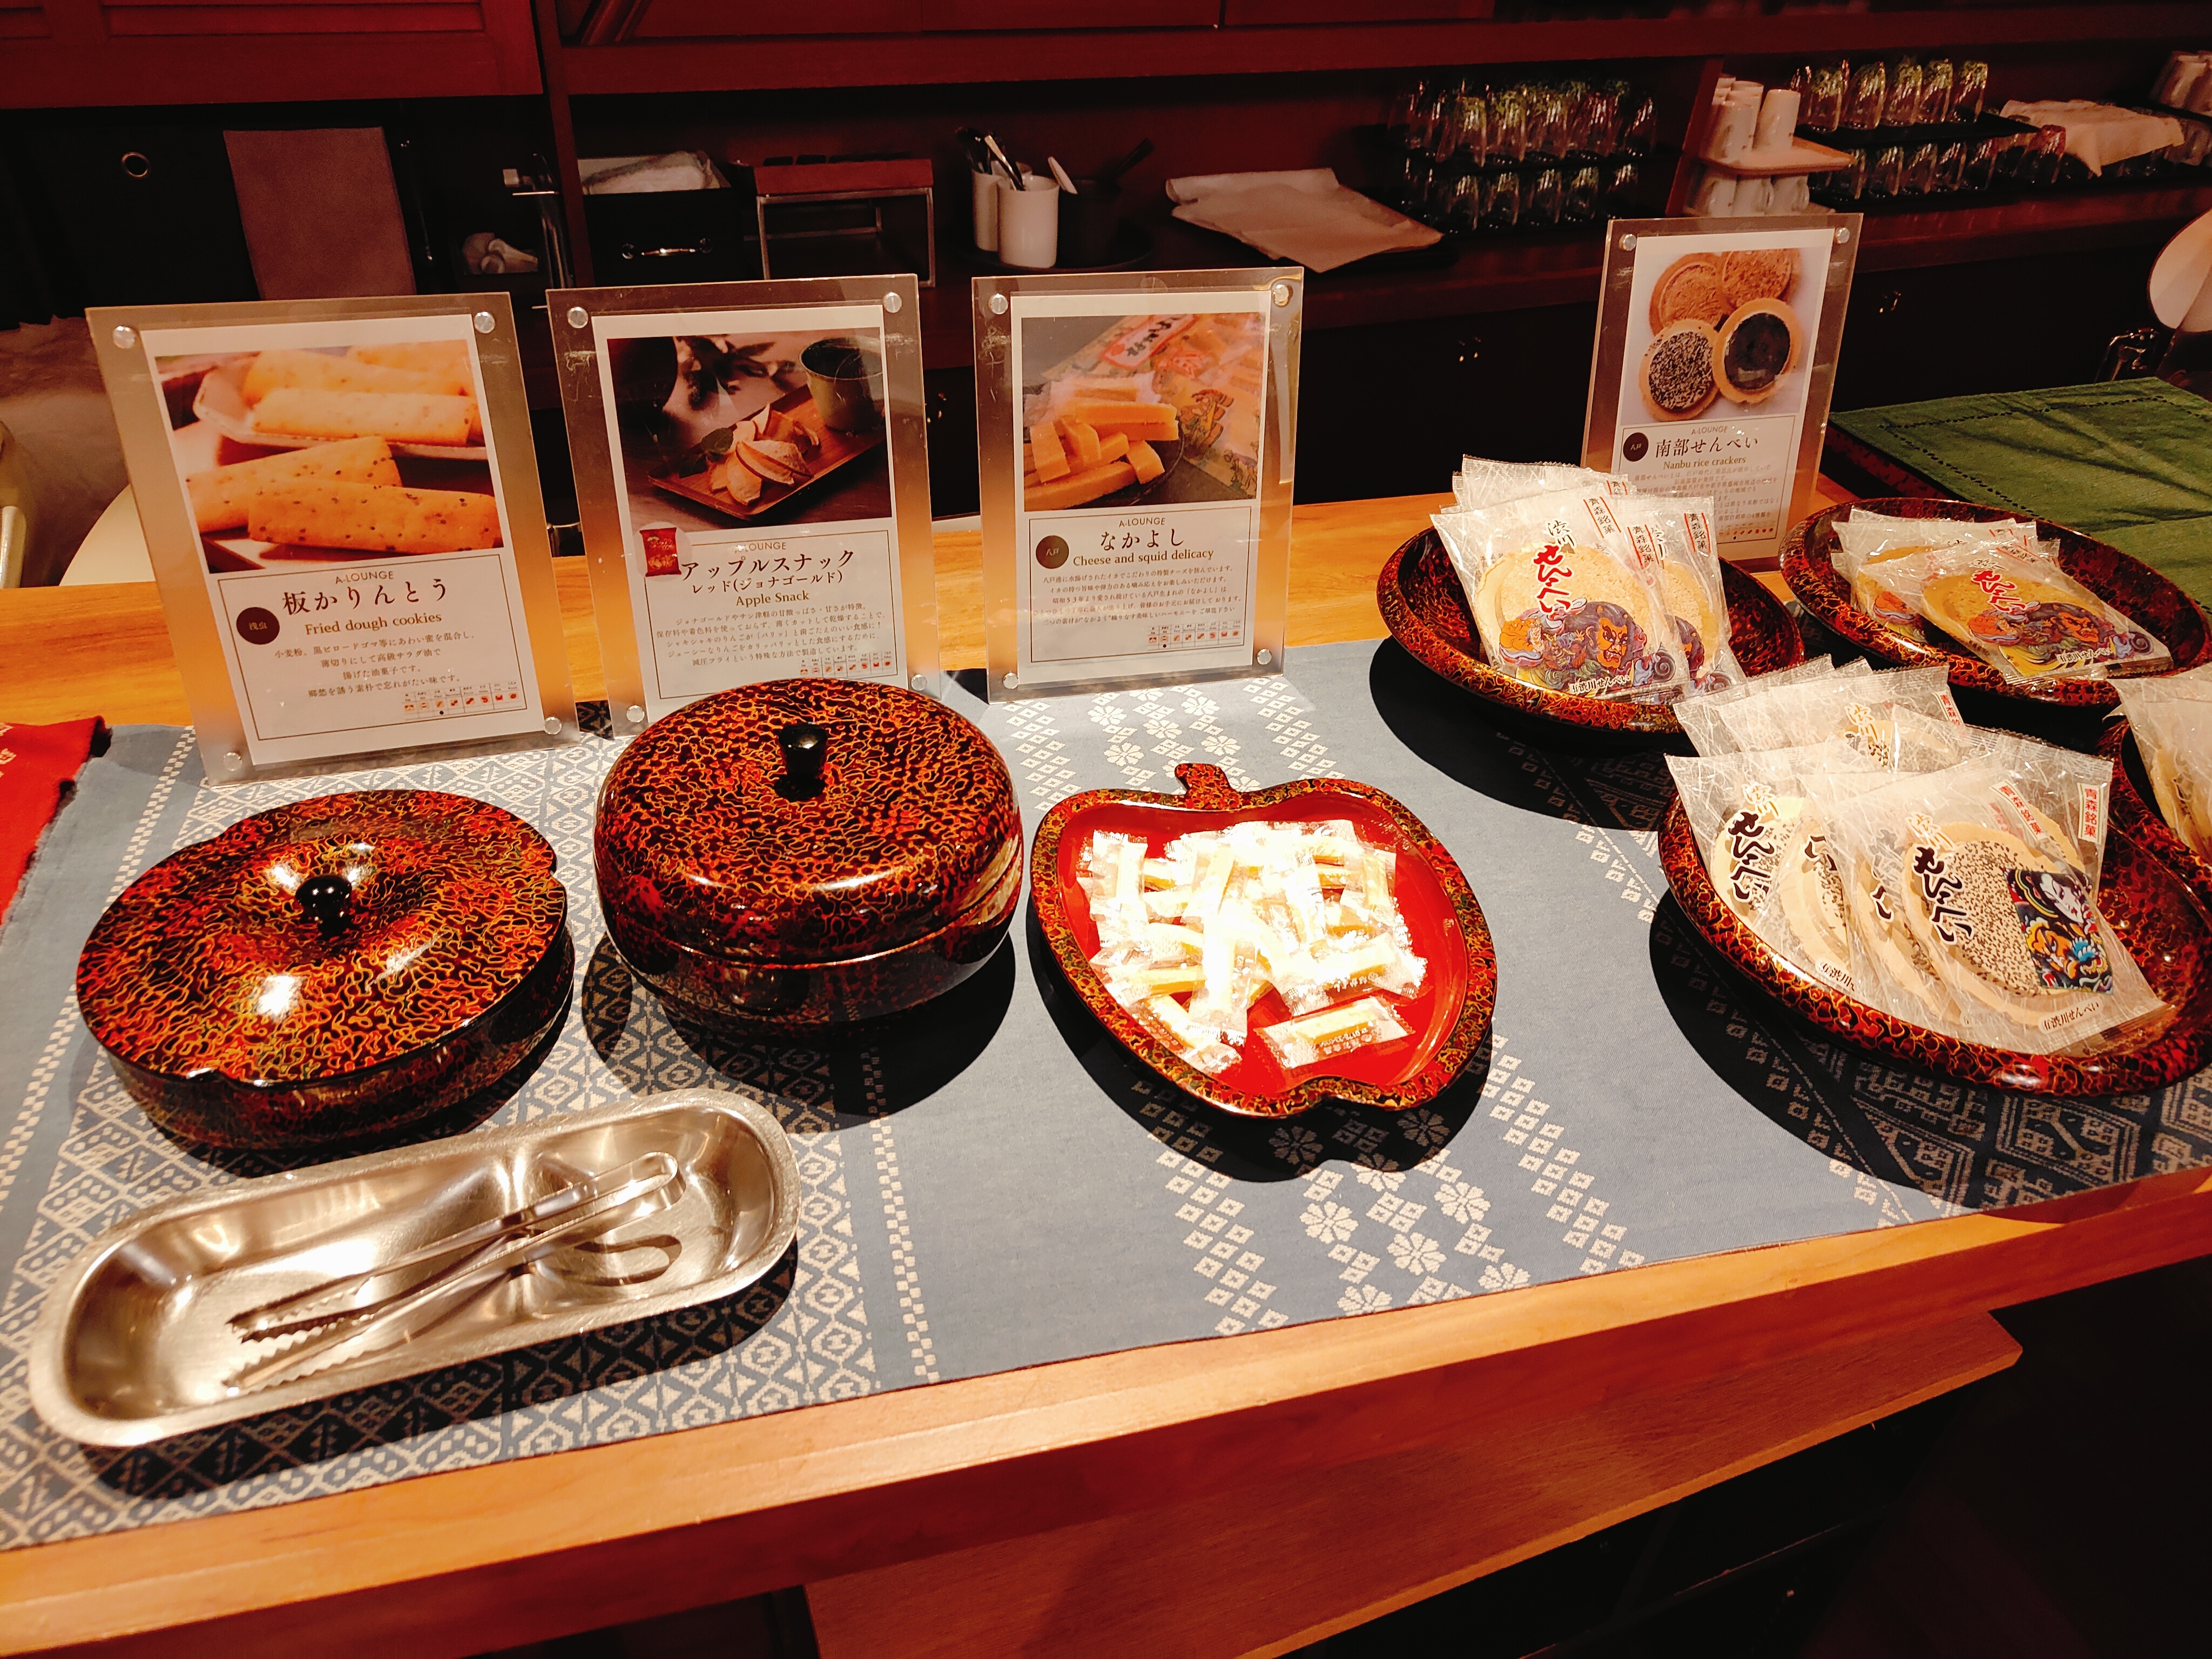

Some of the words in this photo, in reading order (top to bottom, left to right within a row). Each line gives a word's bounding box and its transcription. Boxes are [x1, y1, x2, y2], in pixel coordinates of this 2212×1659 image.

[1655, 437, 1758, 458] 南部せんべい
[1663, 460, 1691, 470] Nanbu
[1694, 458, 1709, 468] rice
[1712, 456, 1746, 466] crackers
[1119, 517, 1165, 528] A-LOUNGE
[1589, 497, 1615, 535] 青森銘菓
[1688, 513, 1708, 549] 青森銘菓
[1100, 528, 1184, 551] なかよし
[1547, 520, 1575, 547] 渋川
[1632, 526, 1655, 563] 青森銘菓
[682, 550, 854, 582] アップルスナック
[1073, 555, 1111, 566] Cheese
[1115, 553, 1134, 564] and
[1138, 551, 1168, 565] squid
[1171, 549, 1214, 561] delicacy
[335, 571, 394, 585] A-LOUNGE
[692, 570, 843, 594] レッド(ジョナゴールド)
[1533, 545, 1573, 613] せんべい
[1972, 570, 2026, 612] せんべい
[282, 578, 447, 615] 板かりんとう
[736, 594, 771, 608] Apple
[775, 590, 809, 603] Snack
[305, 622, 340, 635] Fried
[346, 615, 388, 631] dough
[393, 612, 442, 626] cookies
[1999, 785, 2043, 835] 青森銘菓
[2084, 788, 2098, 838] 青森銘菓
[1728, 812, 1775, 900] せんべい
[1913, 846, 1972, 942] せんべい
